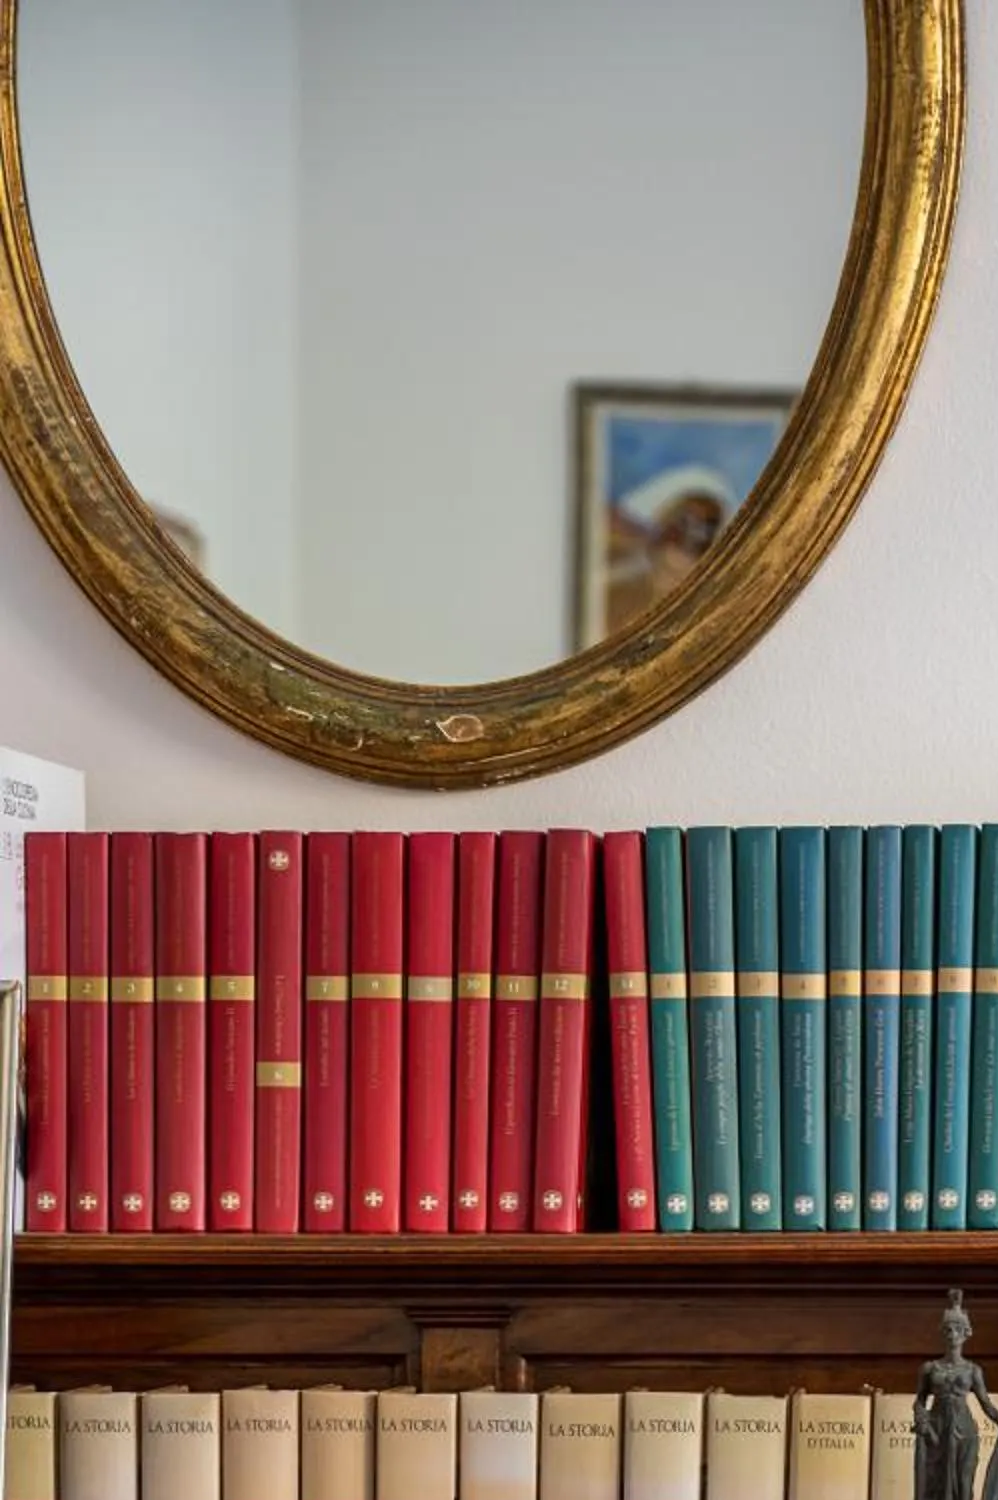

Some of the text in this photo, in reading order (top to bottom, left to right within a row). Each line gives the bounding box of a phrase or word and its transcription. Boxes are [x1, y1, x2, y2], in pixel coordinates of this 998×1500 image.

[10, 1416, 50, 1430] TORIA
[66, 1419, 131, 1433] LA STORIA
[148, 1419, 213, 1433] LA STORIA
[227, 1419, 291, 1432] LA STORIA
[307, 1419, 372, 1432] LA STORIA
[381, 1419, 447, 1432] LA STORIA
[467, 1419, 533, 1433] LA STORIA
[629, 1419, 694, 1433] LA STORIA
[715, 1419, 781, 1433] LA STORIA
[799, 1420, 865, 1435] LA STORIA
[881, 1420, 897, 1432] LA
[550, 1424, 615, 1437] LA STORIA
